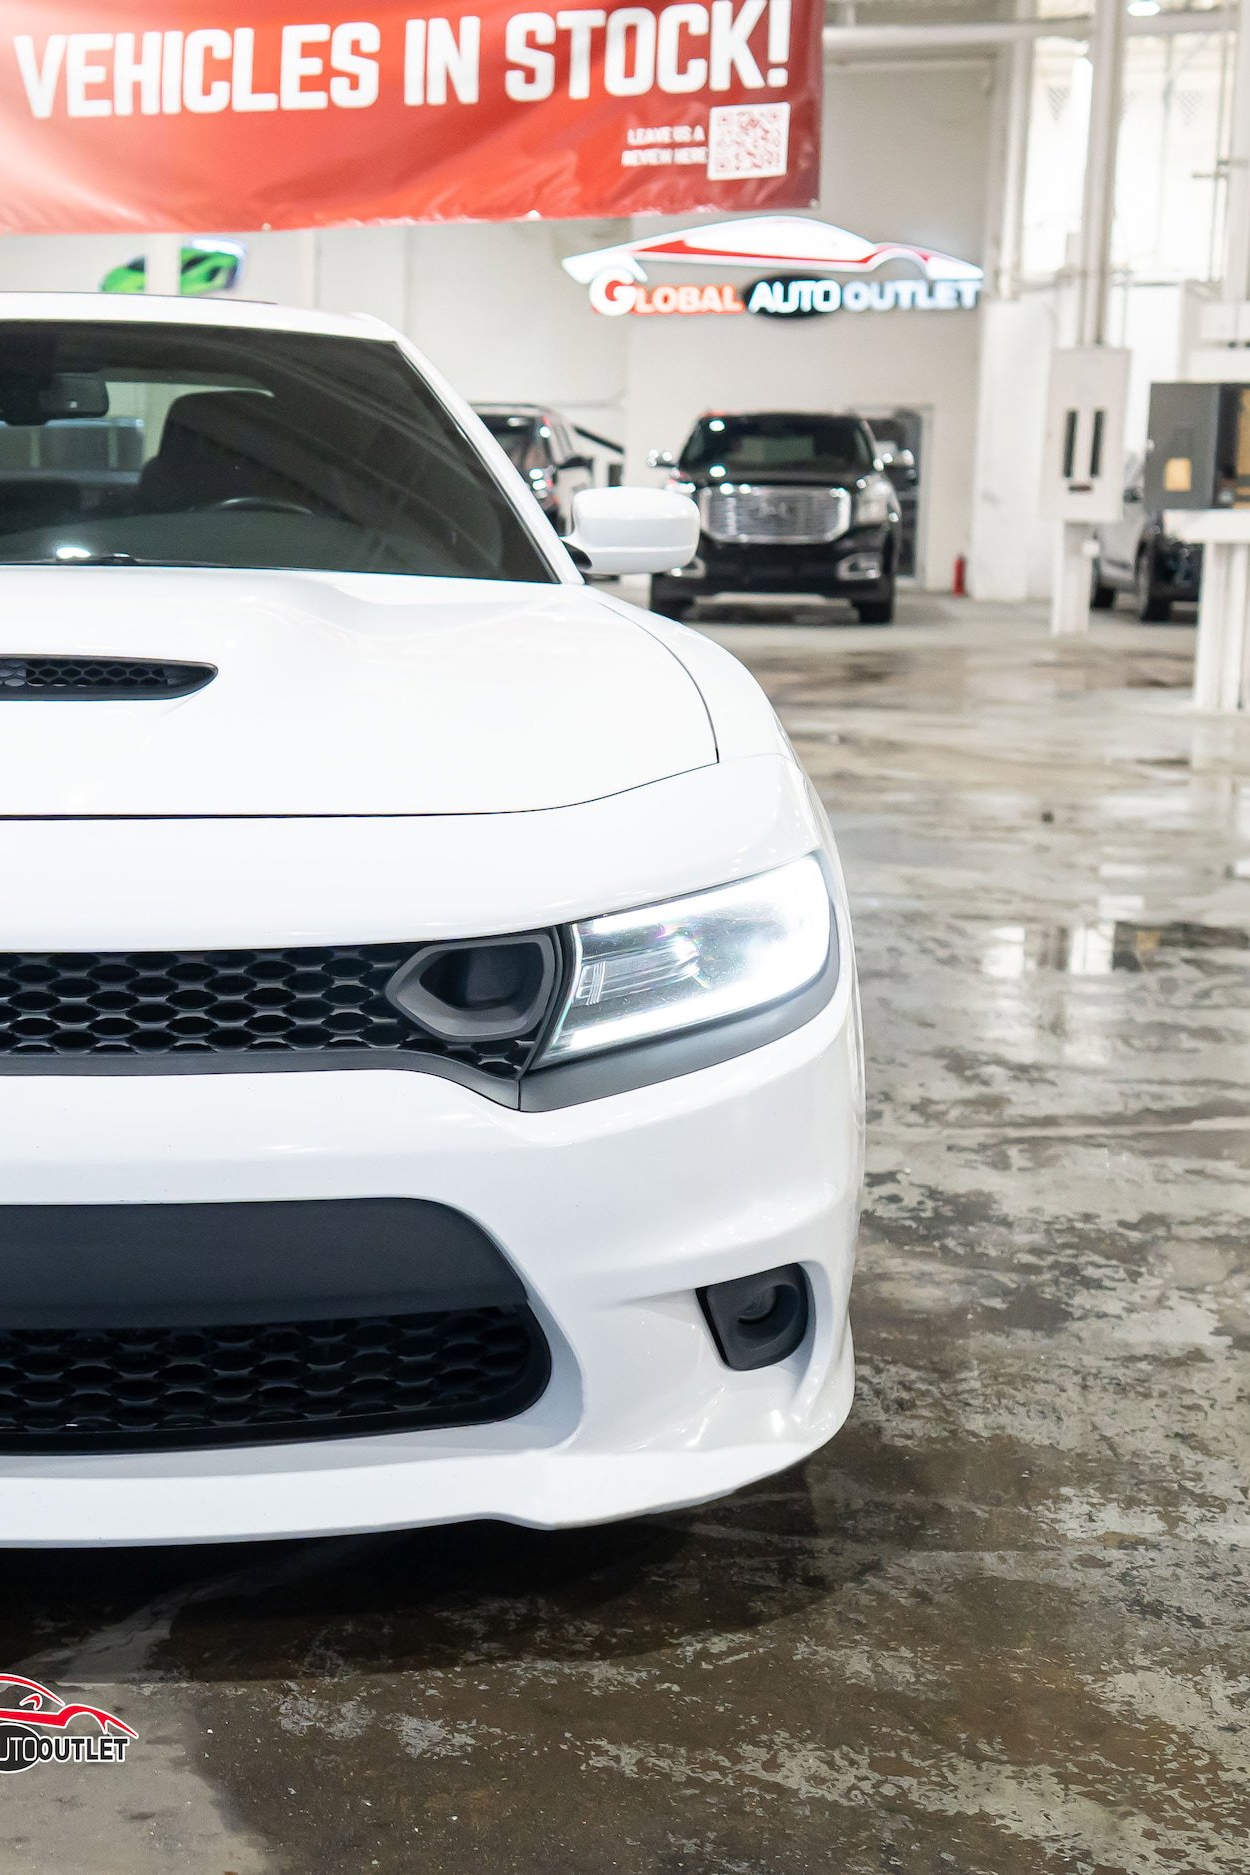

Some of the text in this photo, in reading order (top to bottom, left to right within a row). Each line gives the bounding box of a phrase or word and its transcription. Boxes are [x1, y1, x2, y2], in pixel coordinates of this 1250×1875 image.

[14, 22, 381, 118] VEHICLES
[404, 16, 481, 105] IN
[505, 0, 791, 102] STOCK!
[589, 267, 982, 316] GLOBAL AUTO OUTLET
